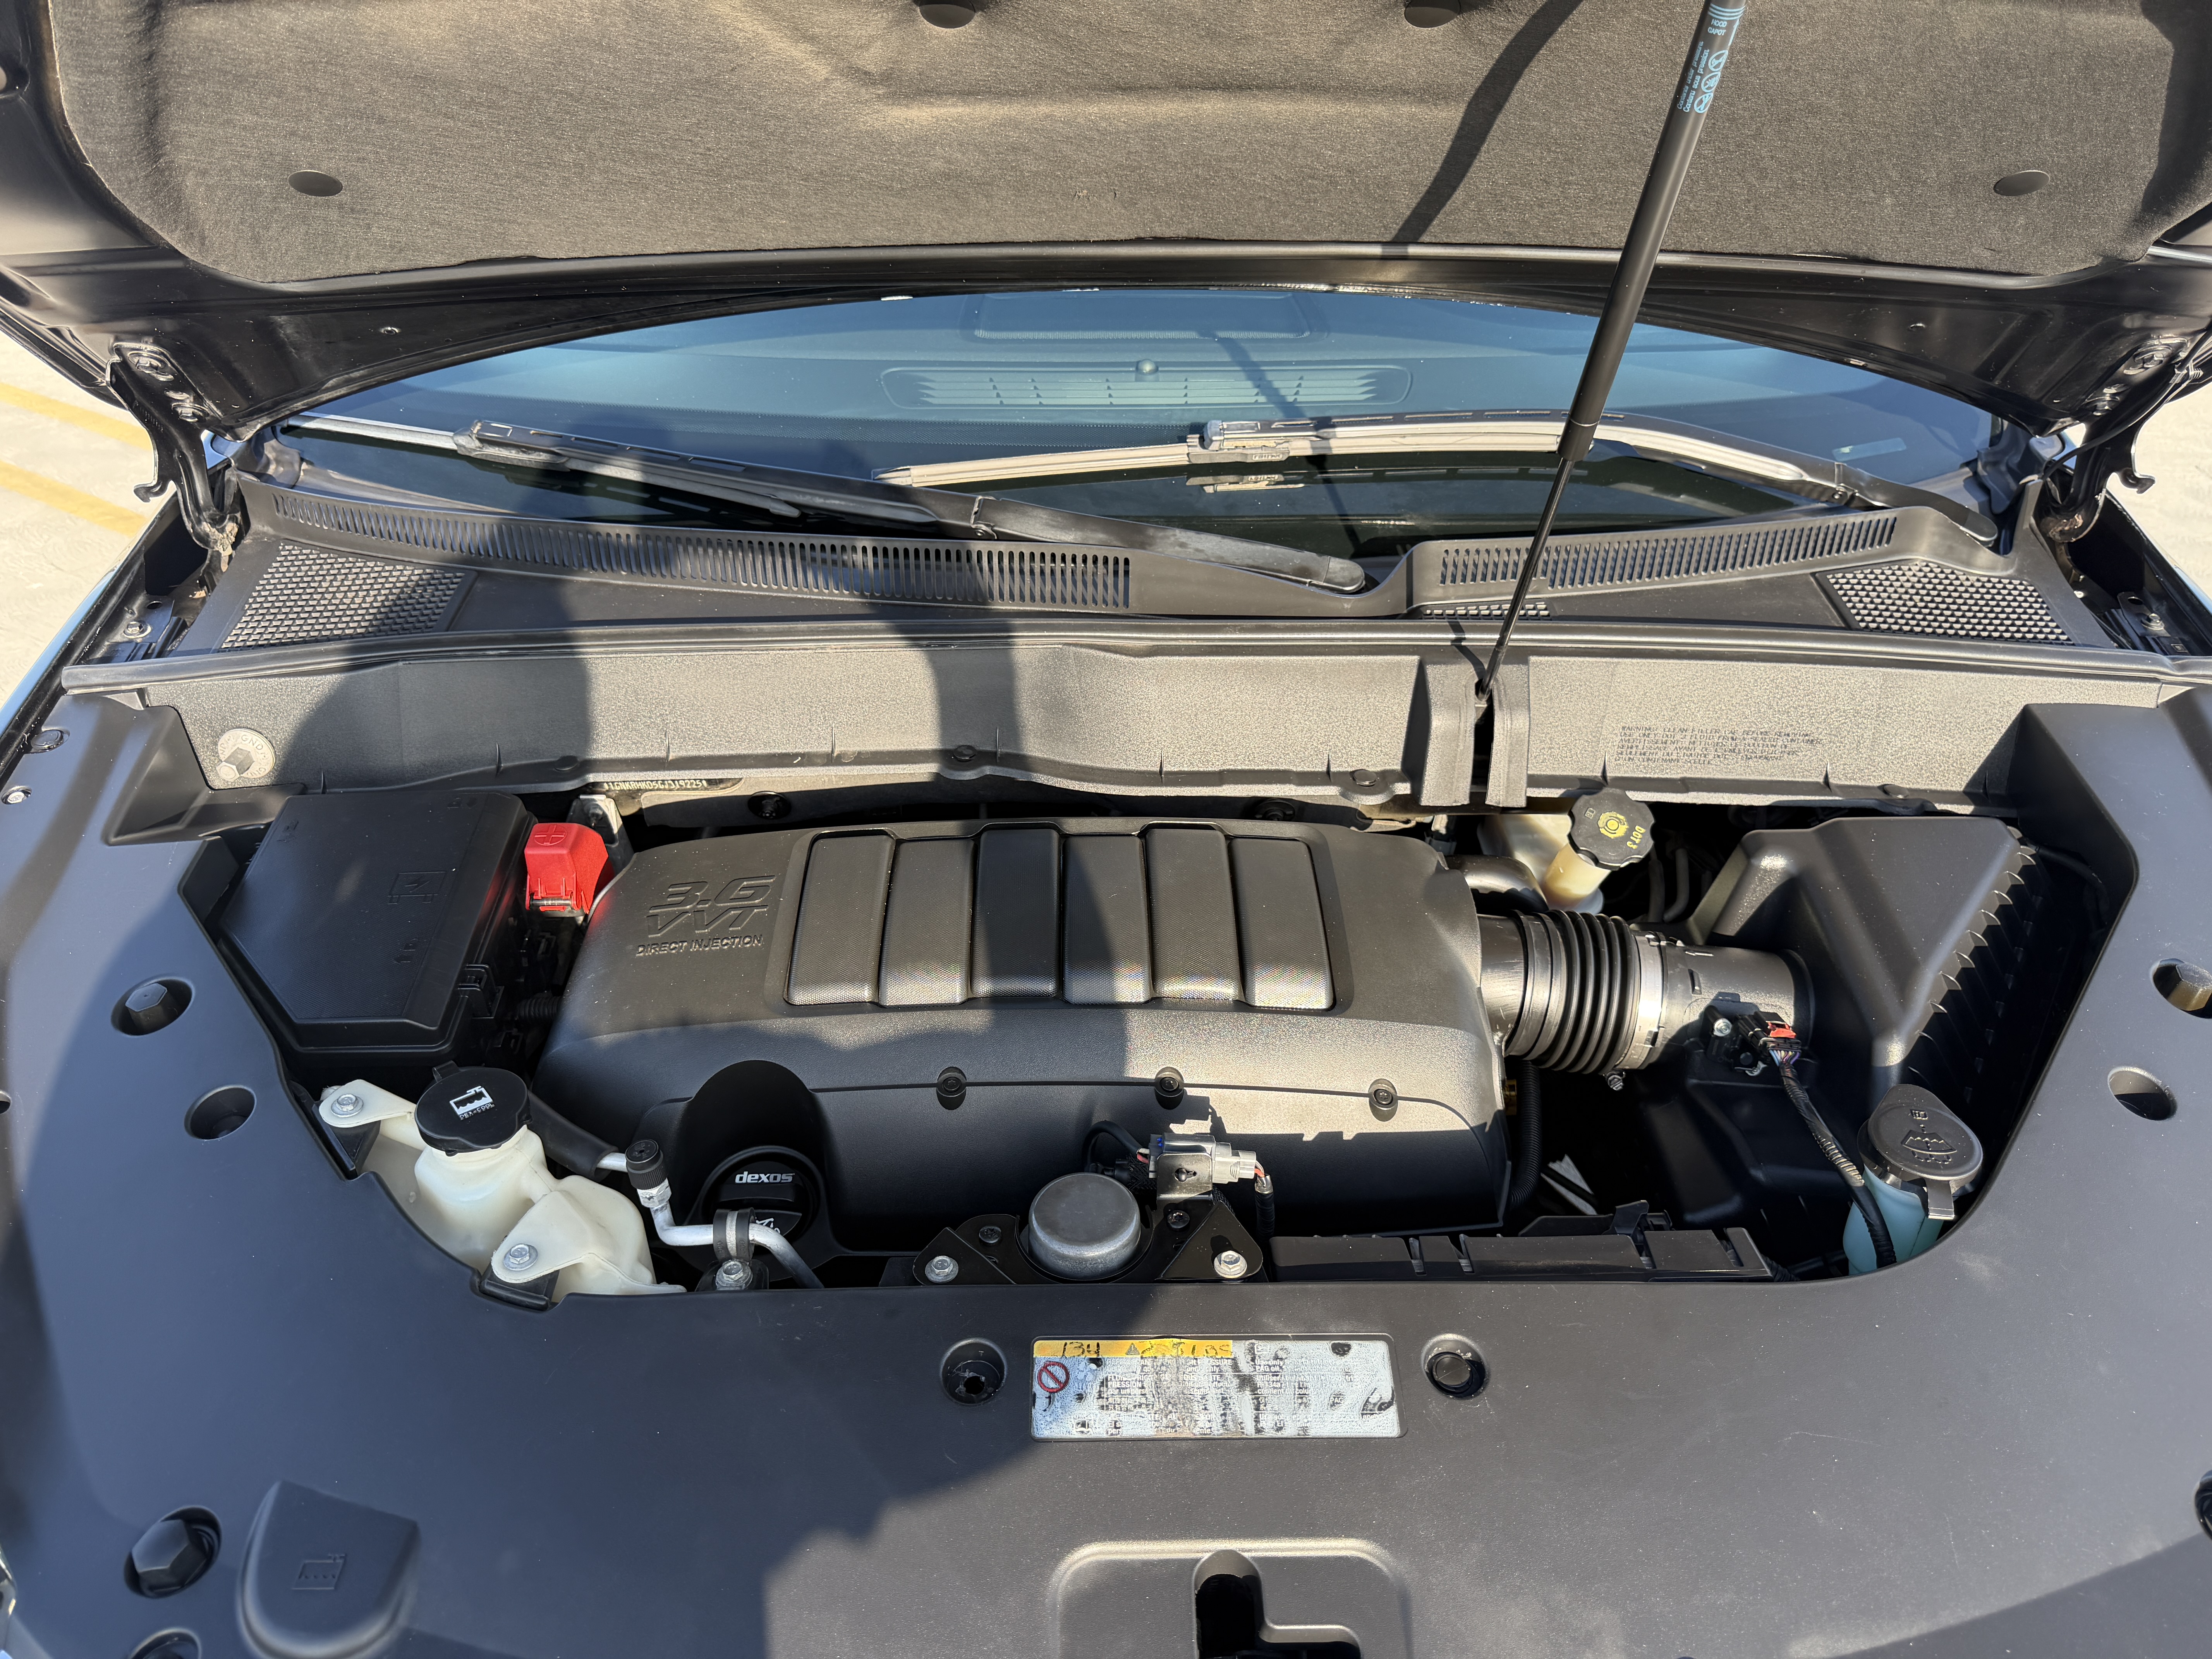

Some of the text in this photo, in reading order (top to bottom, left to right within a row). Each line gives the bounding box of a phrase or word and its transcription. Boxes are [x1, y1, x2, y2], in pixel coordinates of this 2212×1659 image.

[1711, 19, 1727, 27] HOOD
[1686, 68, 1695, 84] under
[1683, 90, 1695, 112] Contenu
[241, 734, 263, 750] GND
[1626, 825, 1646, 849] DOT 3
[649, 875, 777, 913] 3.6
[646, 905, 769, 938] VVT
[636, 934, 764, 957] DIRECT INJECTION
[735, 1171, 795, 1183] dexos
